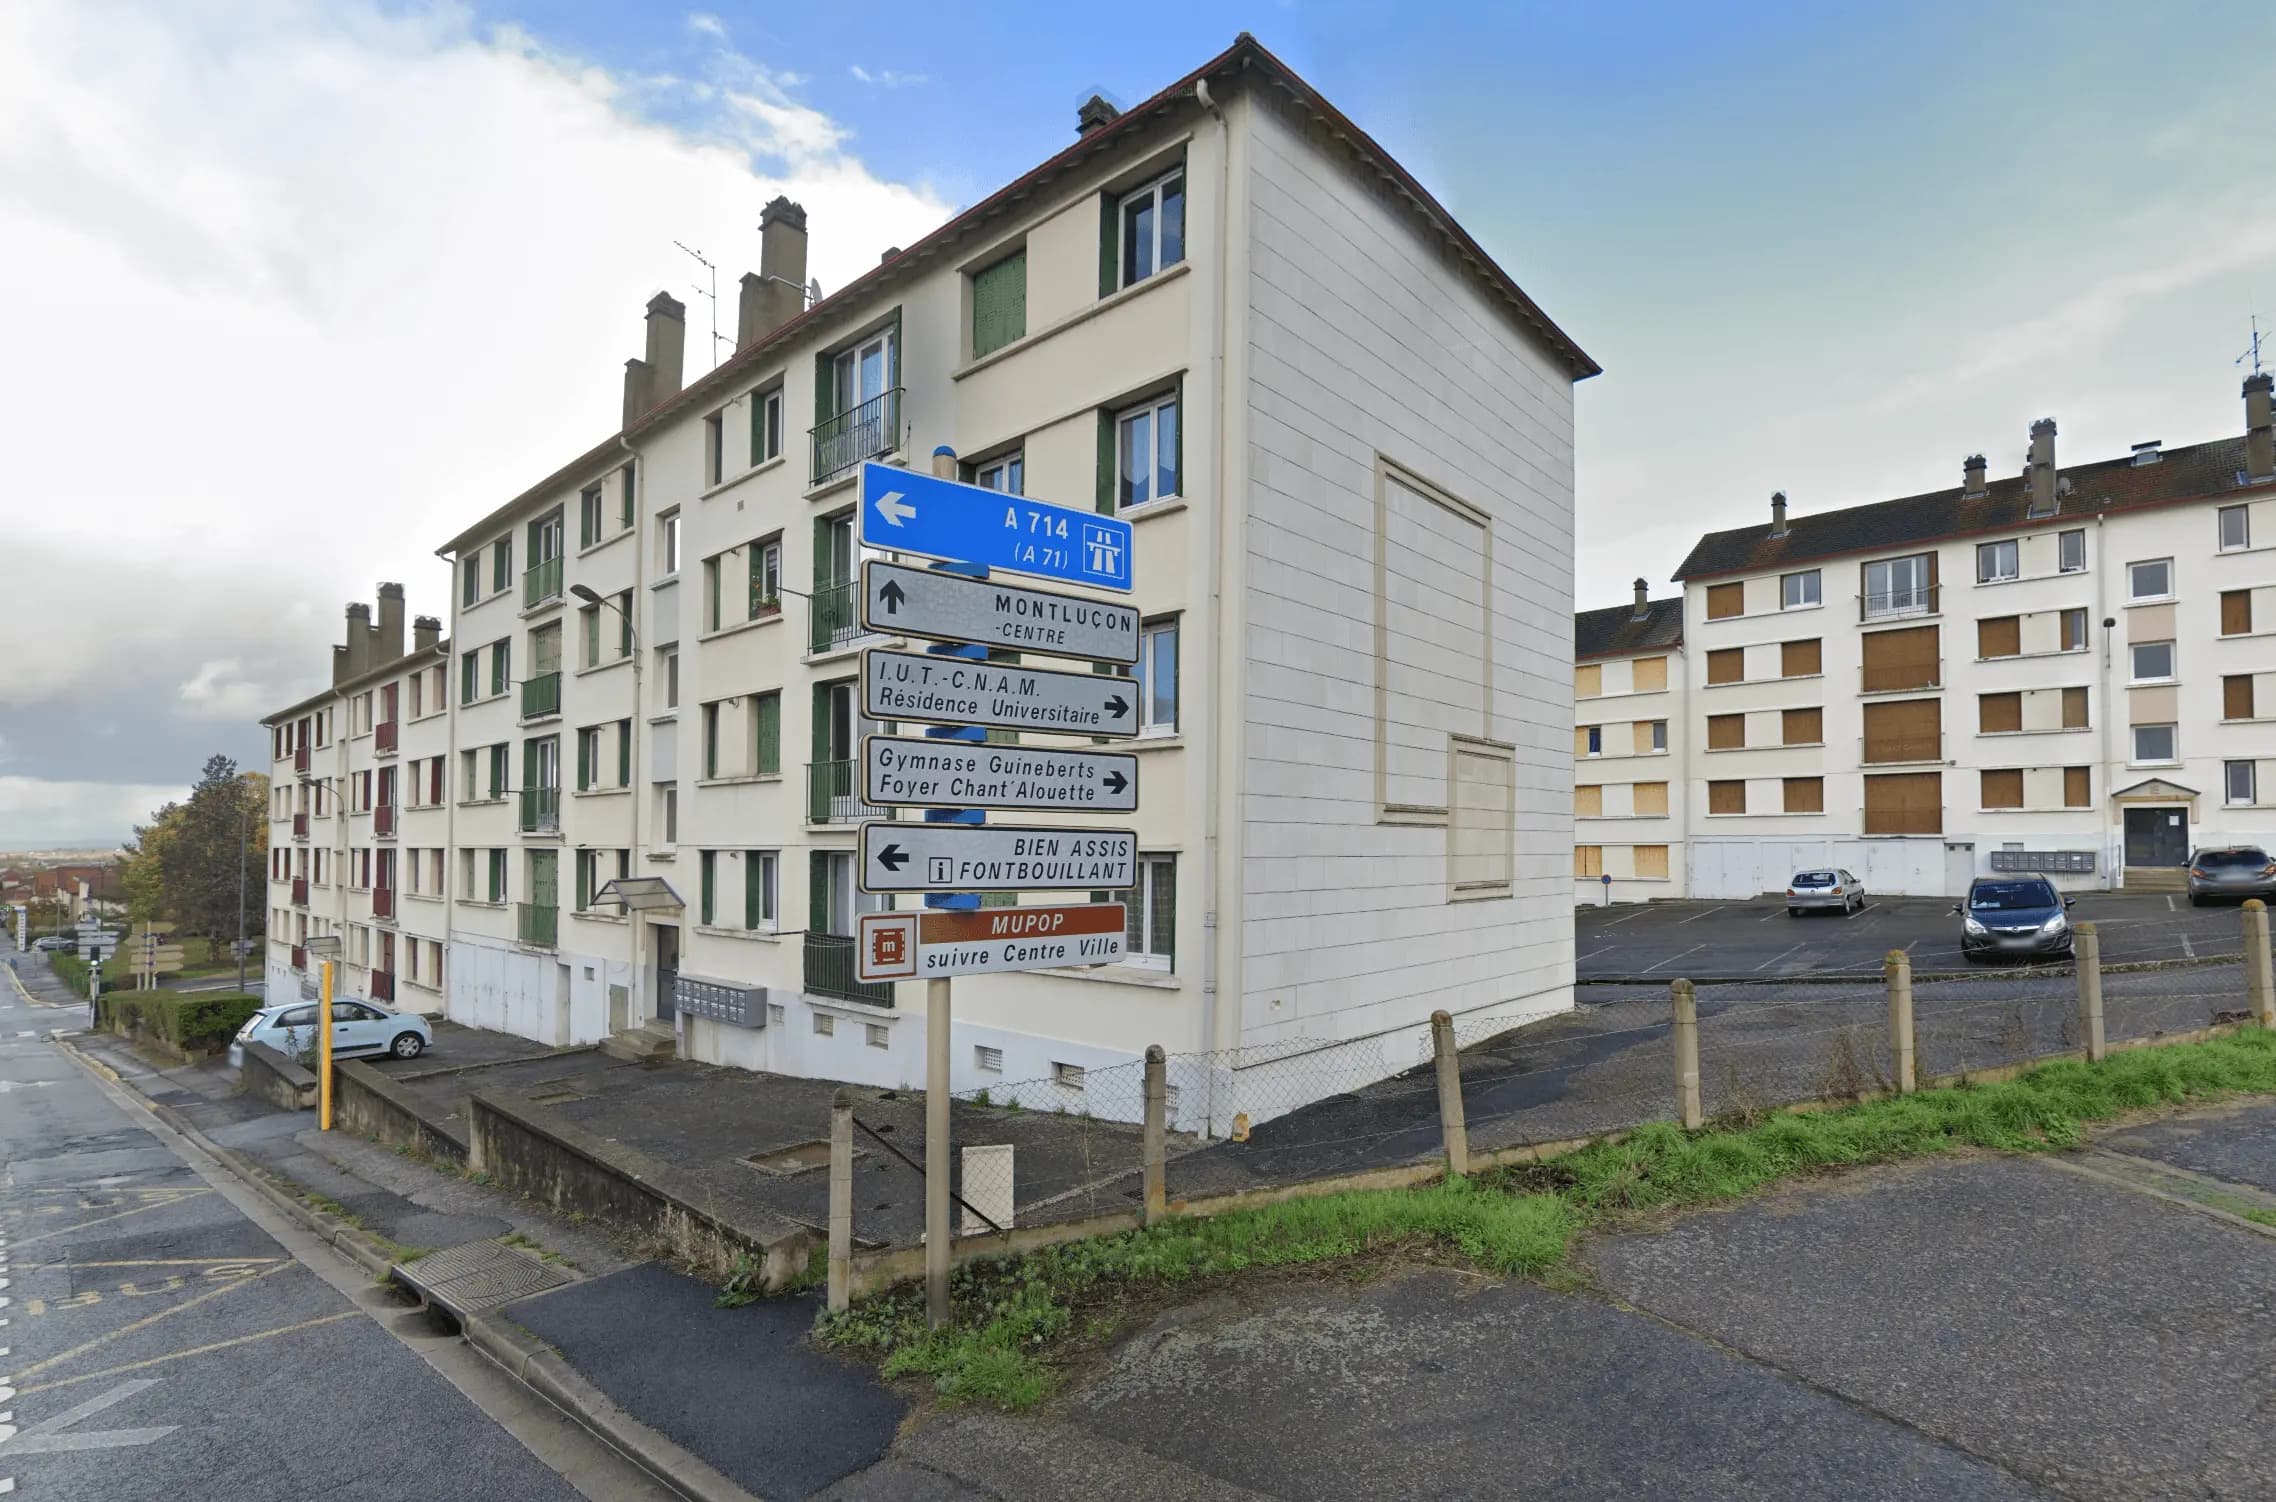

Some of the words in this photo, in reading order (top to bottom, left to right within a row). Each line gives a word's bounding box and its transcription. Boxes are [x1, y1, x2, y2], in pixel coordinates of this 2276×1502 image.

[1004, 507, 1018, 530] A
[1028, 512, 1069, 540] 714
[1015, 542, 1035, 562] (A
[1042, 548, 1069, 570] 71)
[995, 594, 1131, 632] MONTLUÇON
[880, 687, 978, 714] Résidence
[992, 699, 1099, 725] Universitaire
[879, 748, 976, 773] Gymnase
[989, 755, 1095, 779] Guineberts
[880, 774, 939, 798] Foyer
[1014, 838, 1059, 857] BIEN
[1071, 840, 1128, 857] ASSIS
[959, 862, 1127, 880] FONTBOUILLANT
[991, 913, 1064, 935] MUPOP
[927, 948, 989, 969] suivre
[1004, 943, 1065, 962] Centre
[1079, 937, 1118, 957] Ville
